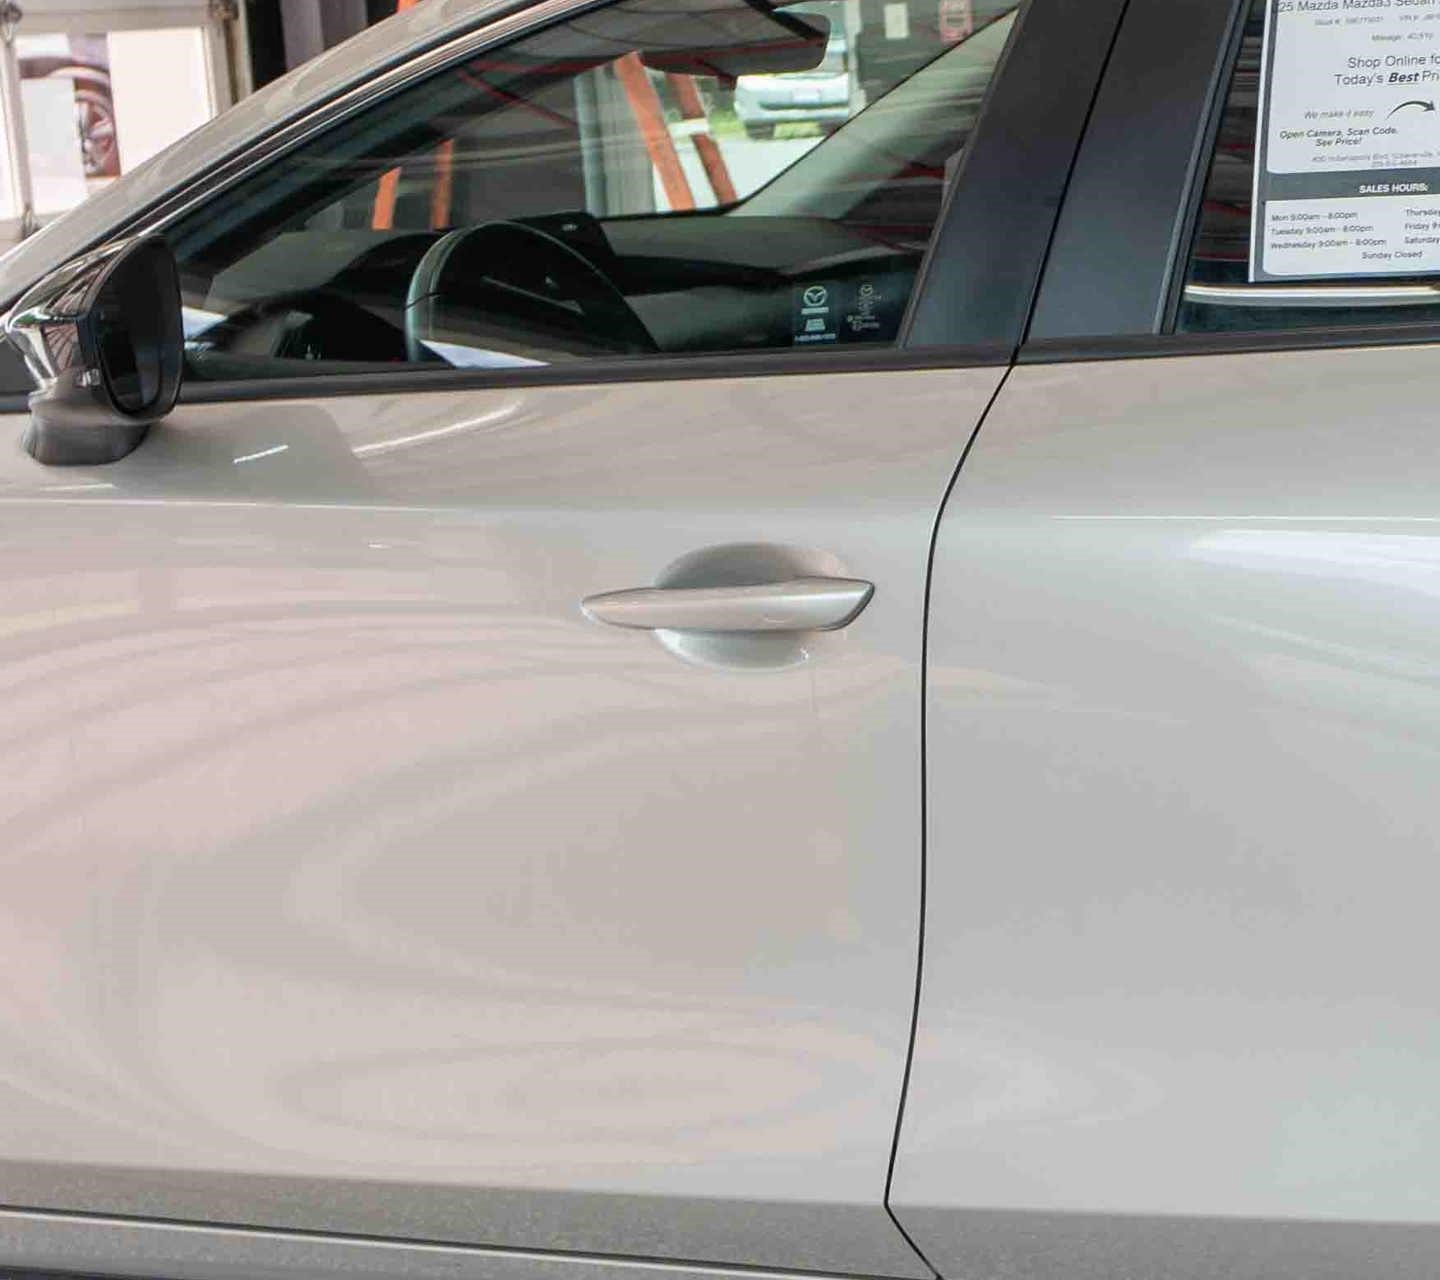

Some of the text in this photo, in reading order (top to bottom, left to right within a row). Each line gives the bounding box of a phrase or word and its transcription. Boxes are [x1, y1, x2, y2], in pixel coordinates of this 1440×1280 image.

[1297, 0, 1338, 11] Mazda
[1348, 56, 1380, 69] Shop
[1385, 54, 1427, 67] Online
[1334, 73, 1384, 87] Today's
[1388, 71, 1420, 84] Best
[1279, 131, 1304, 140] Open
[1347, 127, 1370, 136] Scan
[1359, 184, 1390, 194] SALES
[1271, 227, 1304, 236] Tuesday
[1404, 222, 1430, 231] Friday
[1404, 235, 1440, 245] Saturday
[1271, 241, 1316, 251] Wednesday
[1361, 249, 1423, 261] Sunday Closed
